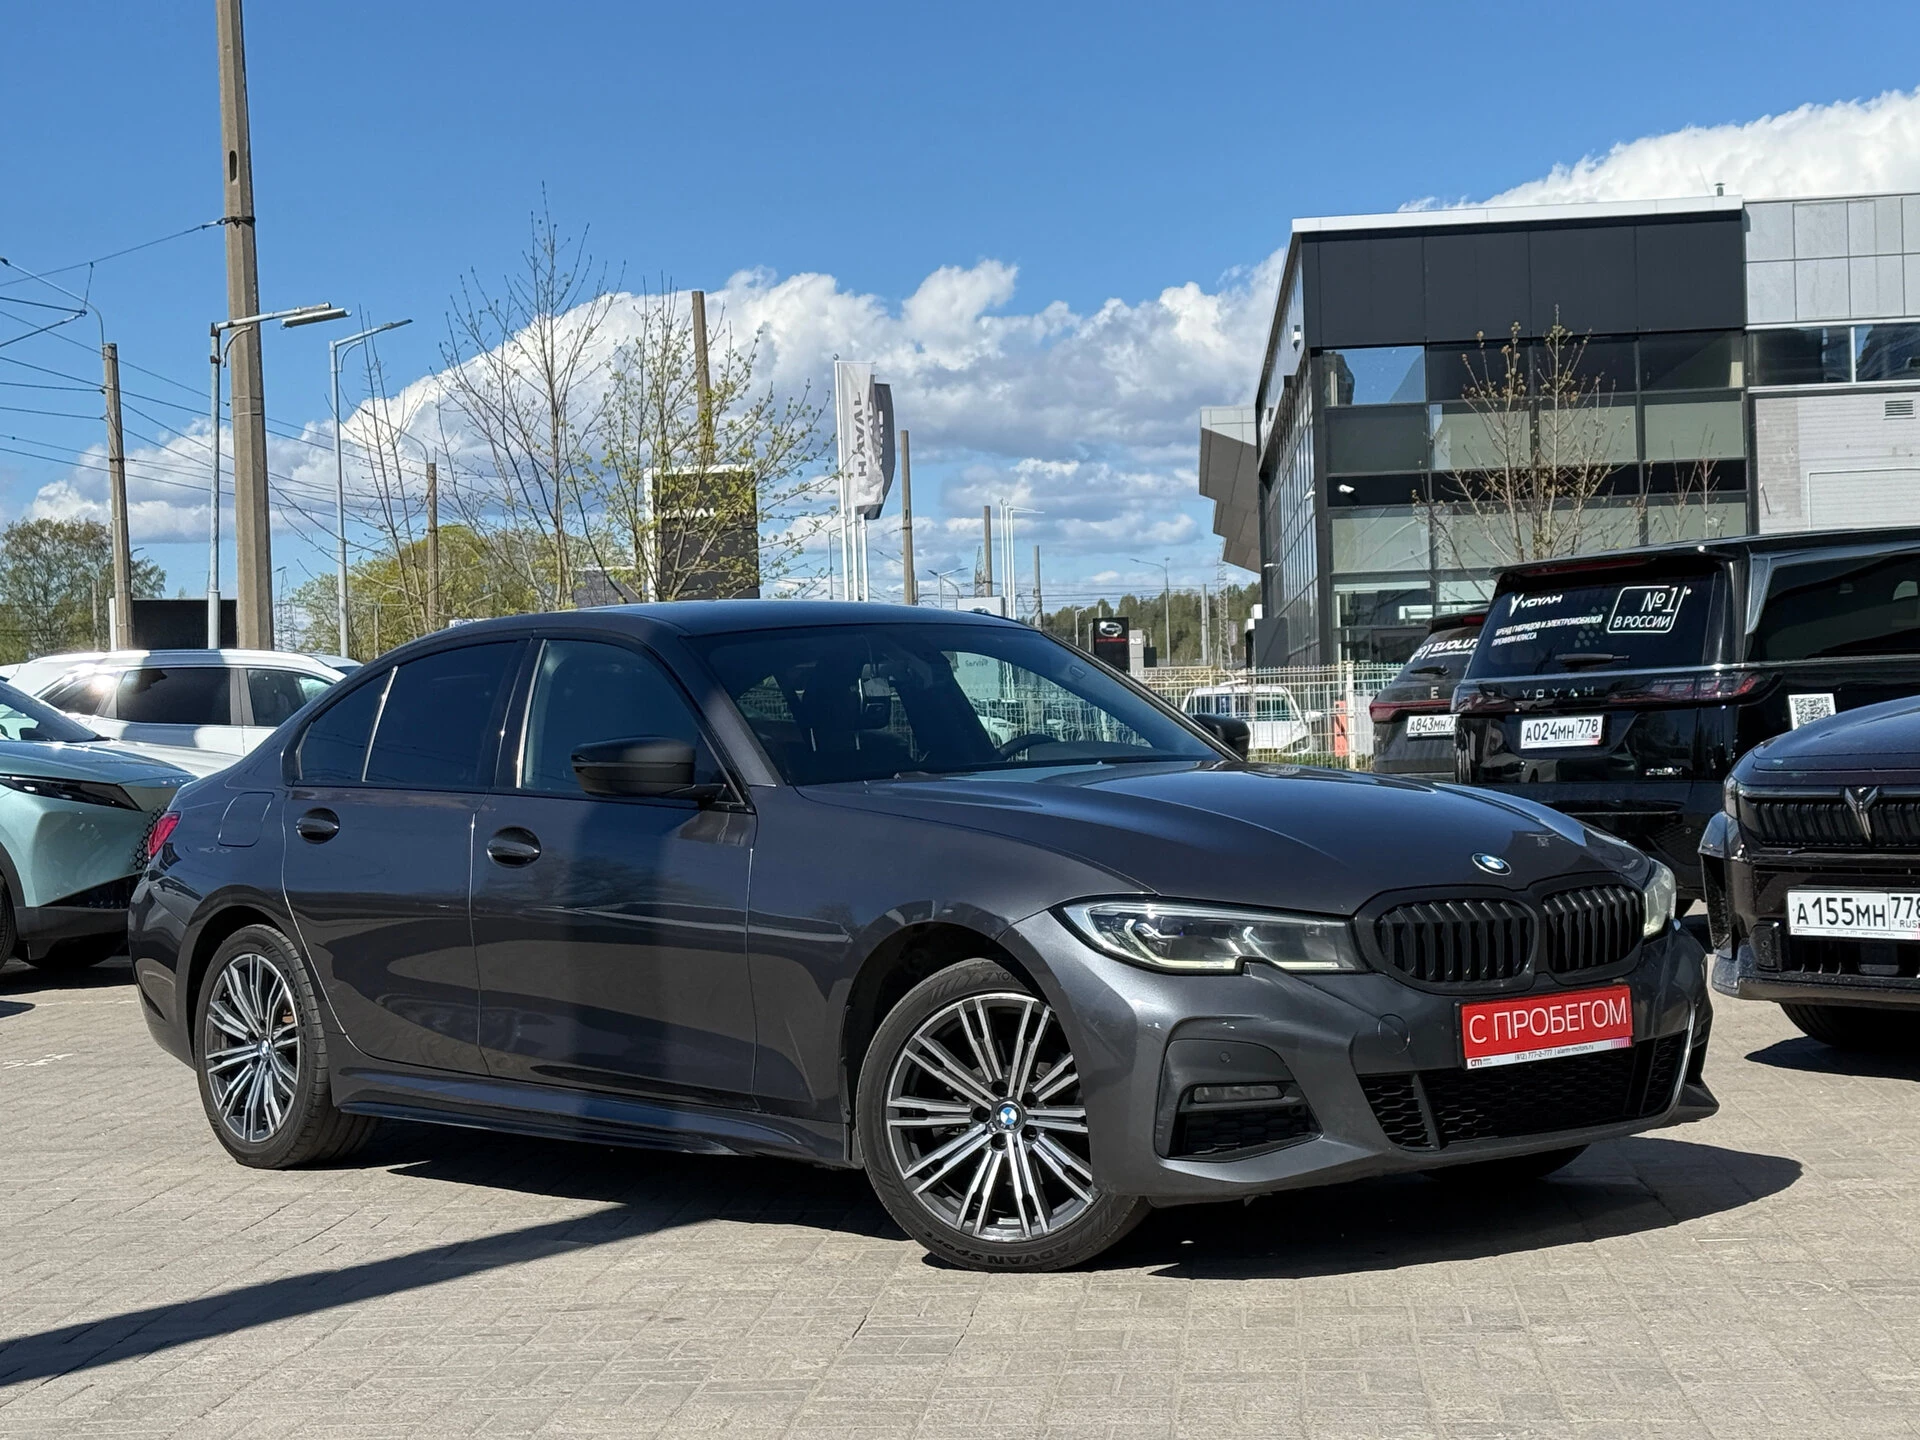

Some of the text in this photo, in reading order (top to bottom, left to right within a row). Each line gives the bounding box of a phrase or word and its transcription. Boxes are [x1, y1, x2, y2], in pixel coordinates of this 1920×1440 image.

[853, 391, 867, 477] HAVAL
[1520, 594, 1563, 609] VOYAH
[1613, 614, 1672, 629] В РОССИИ
[1431, 638, 1480, 653] EVOLUT
[1522, 686, 1595, 699] VOYAH
[1525, 718, 1599, 742] А024МН 778
[1796, 896, 1886, 927] А155МН
[1899, 919, 1918, 929] RUS
[1469, 997, 1628, 1044] С ПРОБЕГОМ
